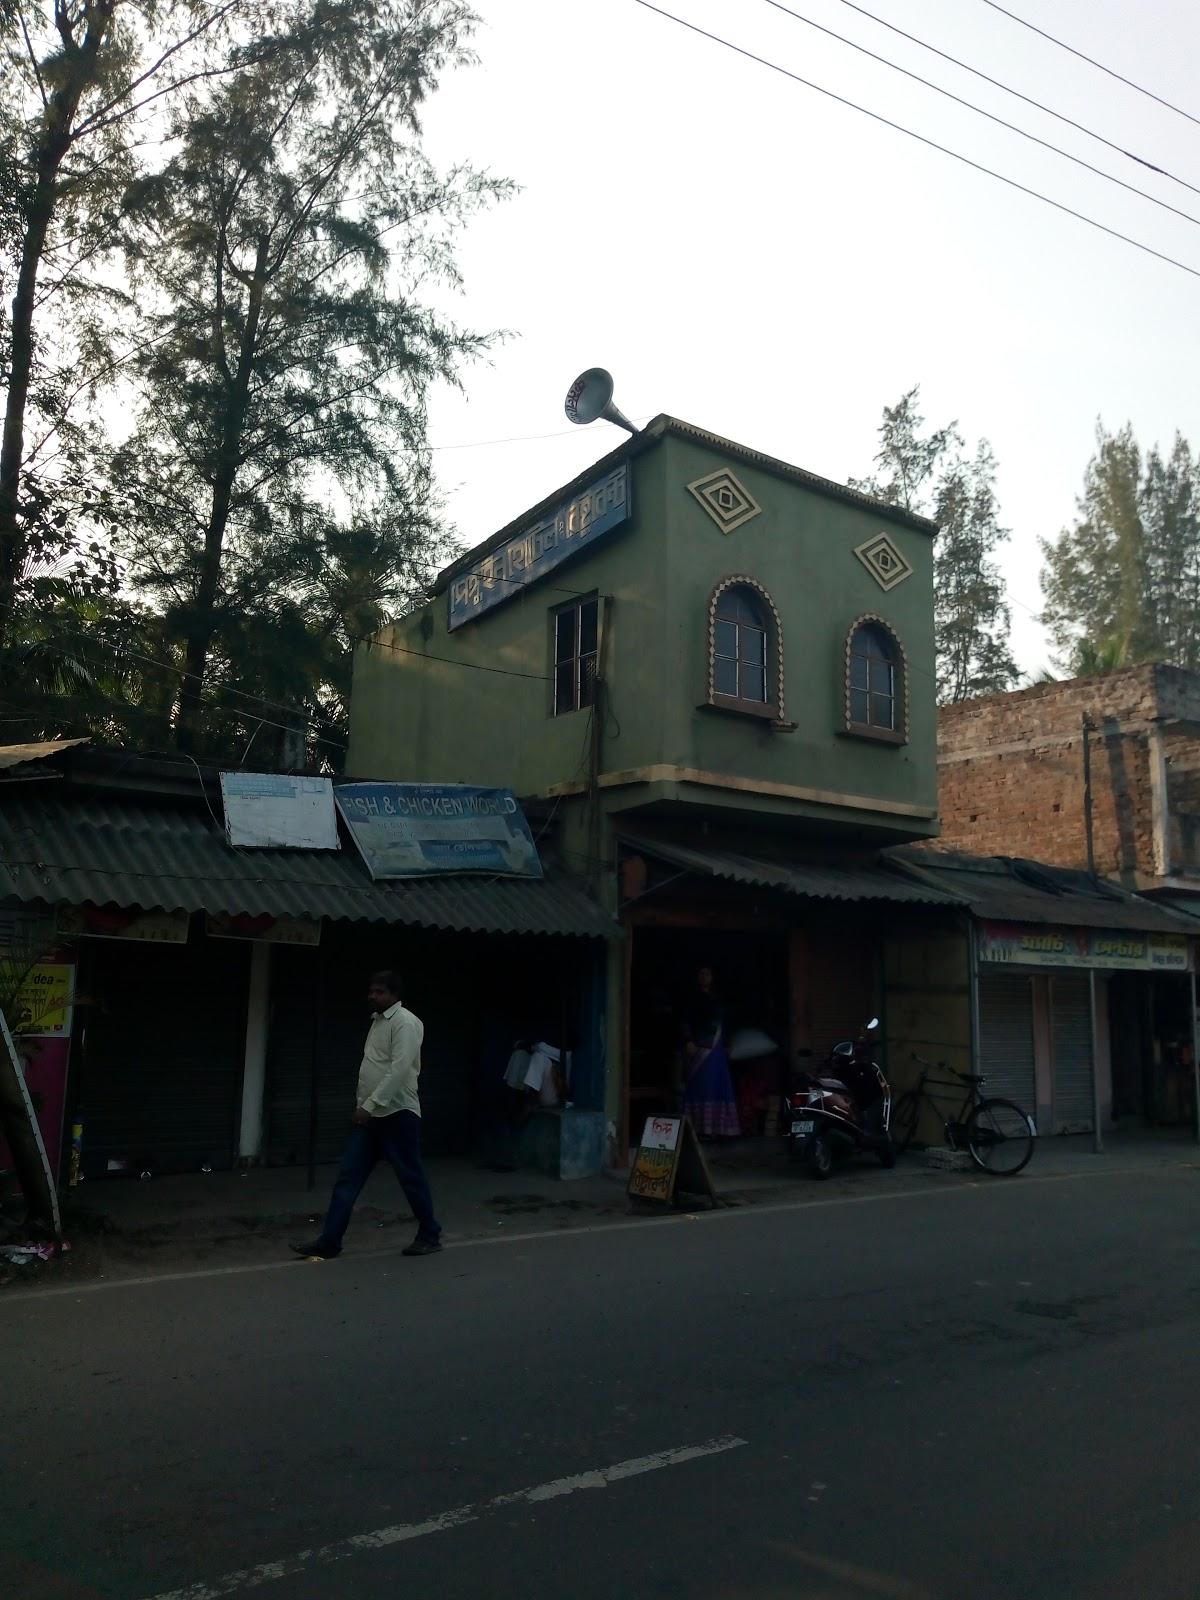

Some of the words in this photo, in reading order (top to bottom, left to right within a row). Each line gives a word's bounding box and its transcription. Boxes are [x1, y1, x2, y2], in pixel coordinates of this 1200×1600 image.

[343, 797, 381, 816] FISH
[384, 797, 397, 814] &
[398, 797, 464, 816] CHICKEN
[465, 796, 518, 815] WORLD
